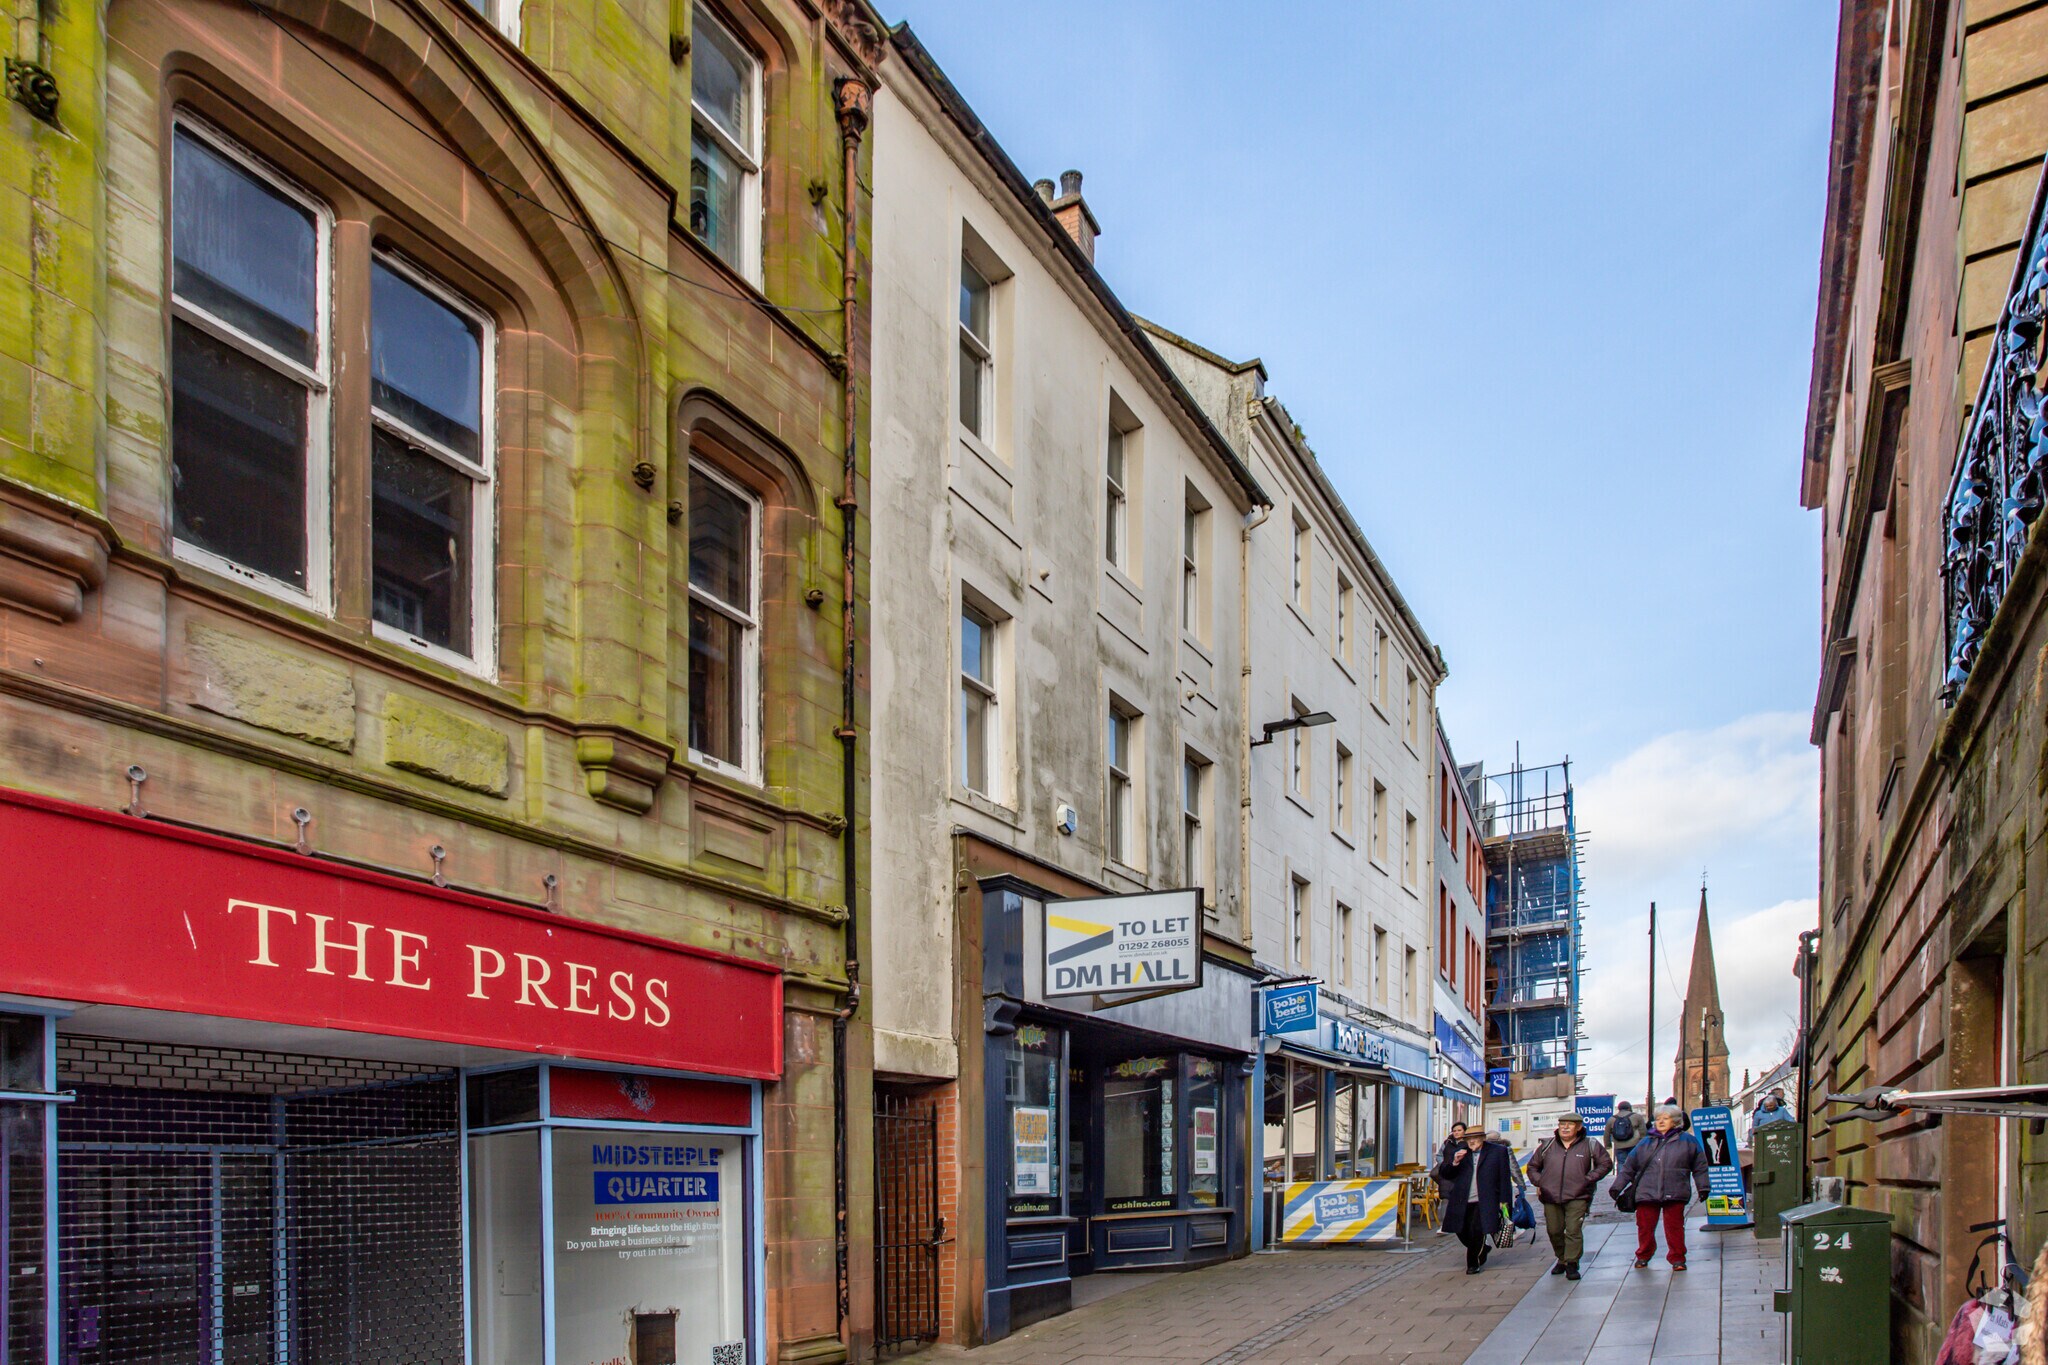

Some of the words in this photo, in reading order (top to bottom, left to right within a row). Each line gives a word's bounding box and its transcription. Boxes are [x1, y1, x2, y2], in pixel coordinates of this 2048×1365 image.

[1119, 921, 1146, 937] TO
[1152, 917, 1190, 934] LET
[1119, 941, 1149, 951] 01292
[1151, 938, 1189, 949] 268055
[1119, 950, 1167, 958] www.dmhall.co.uk
[227, 898, 430, 990] THE
[466, 944, 671, 1027] PRESS
[1055, 964, 1103, 989] DM
[1111, 958, 1189, 985] HALL
[1273, 995, 1306, 1010] bob&
[1275, 1004, 1307, 1018] berts
[1018, 1028, 1046, 1046] SLOTS
[1119, 1059, 1164, 1077] SLOTS
[1492, 1079, 1506, 1095] S
[1576, 1106, 1612, 1114] WHSmith
[1583, 1116, 1606, 1124] Open
[592, 1144, 719, 1166] MIDSTEEPLE
[608, 1176, 707, 1201] QUARTER
[1014, 1203, 1049, 1212] cashino.com
[1112, 1200, 1170, 1209] cashino.com
[1321, 1204, 1359, 1218] berts
[595, 1210, 625, 1221] 100%
[626, 1208, 683, 1221] Community
[686, 1208, 720, 1218] Owned
[591, 1225, 627, 1237] Bringing
[628, 1224, 641, 1233] life
[642, 1223, 660, 1233] back
[662, 1224, 669, 1232] to
[670, 1222, 683, 1231] the
[684, 1222, 701, 1232] High
[566, 1241, 579, 1250] Do
[581, 1242, 597, 1251] you
[599, 1239, 619, 1248] have
[628, 1236, 662, 1246] business
[664, 1234, 680, 1243] idea
[619, 1250, 631, 1260] try
[633, 1249, 646, 1257] out
[648, 1248, 656, 1256] in
[658, 1247, 673, 1256] this
